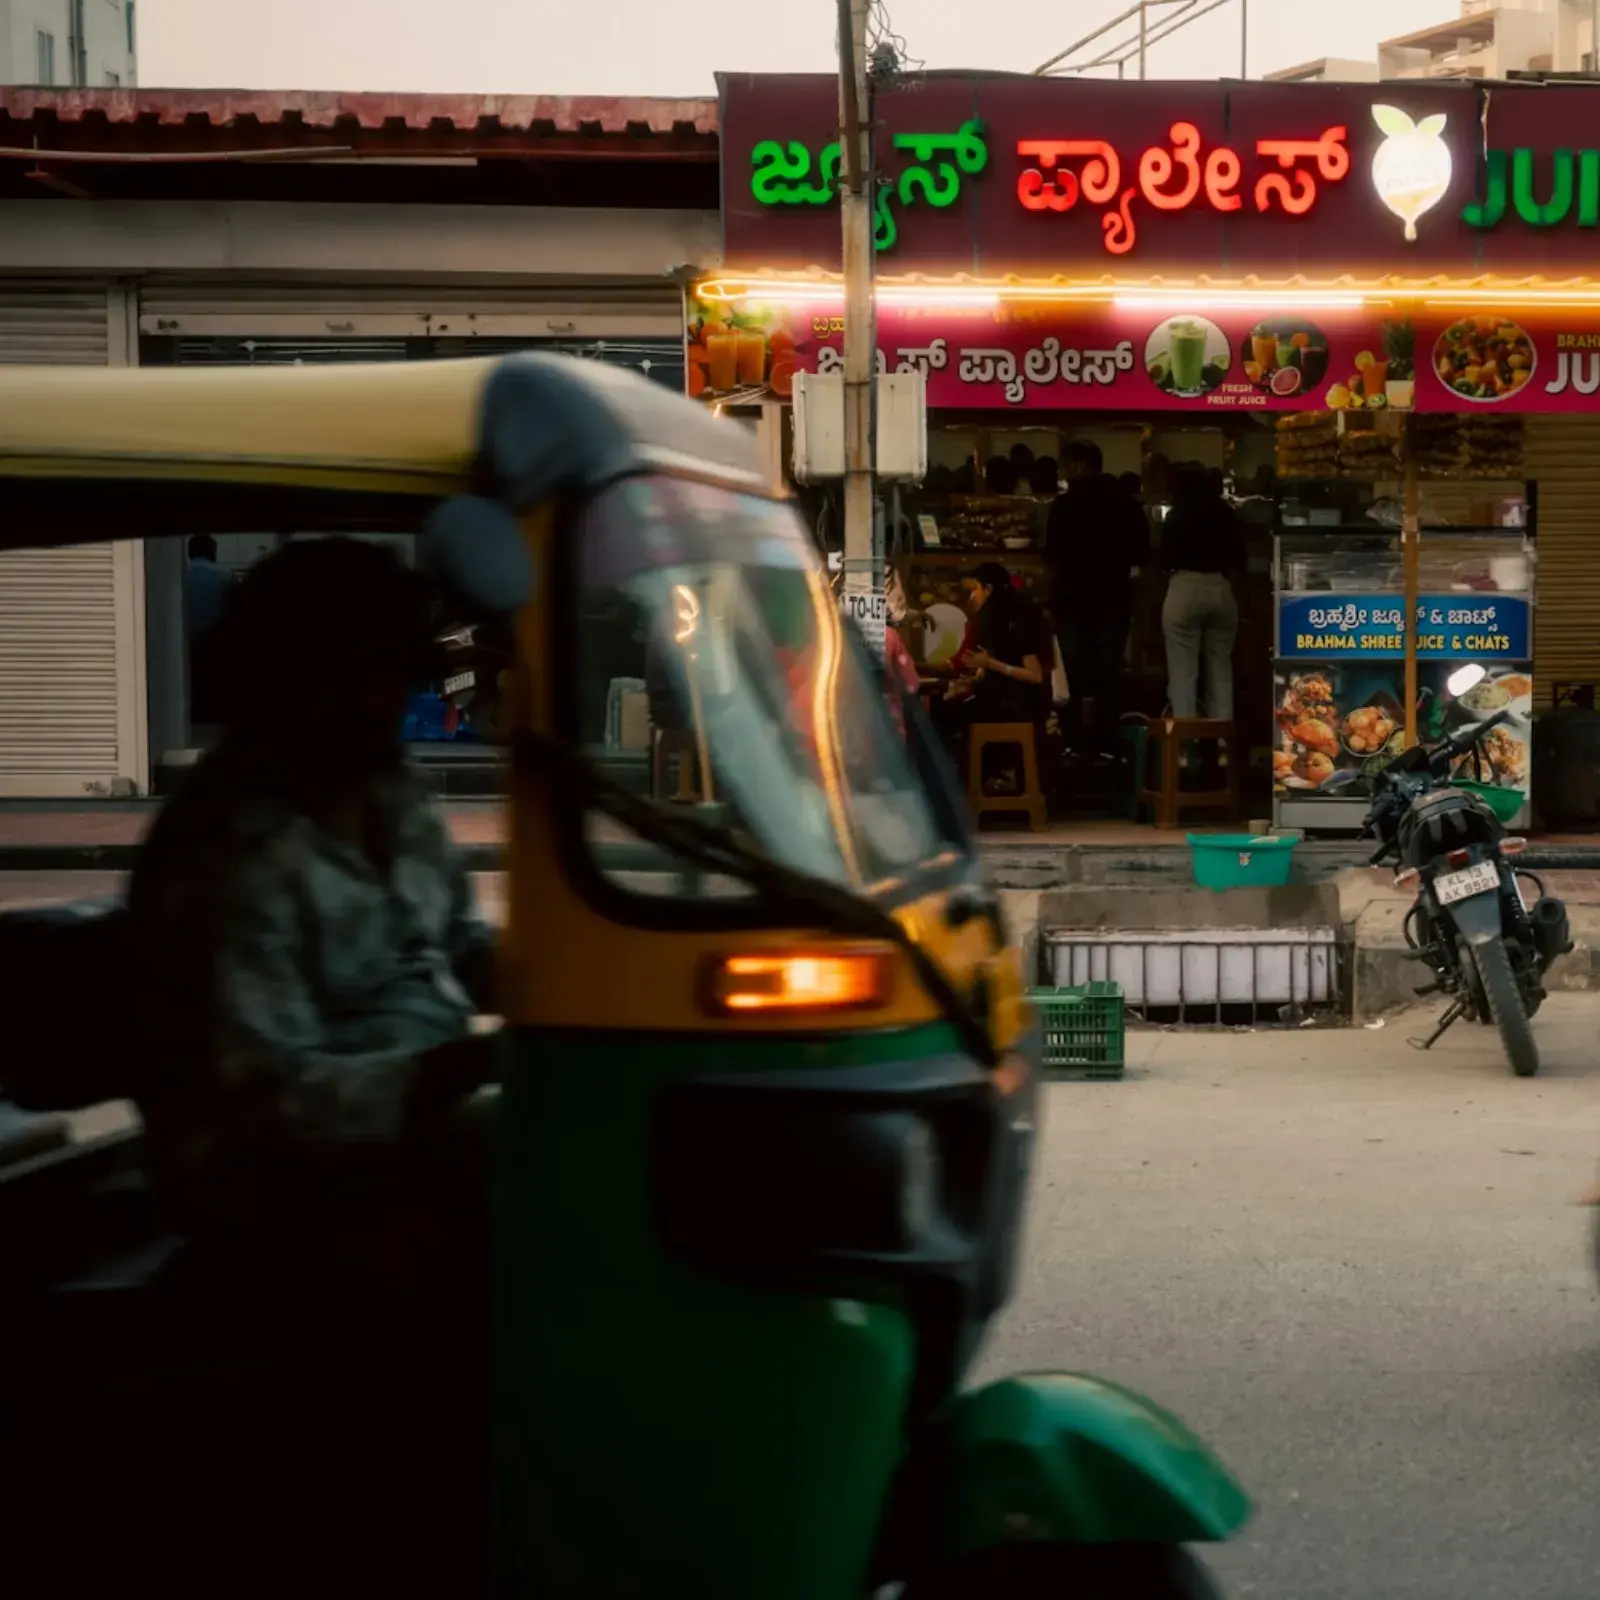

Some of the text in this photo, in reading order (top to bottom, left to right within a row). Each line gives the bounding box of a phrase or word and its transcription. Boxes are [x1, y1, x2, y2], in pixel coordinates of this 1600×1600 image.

[1017, 121, 1350, 254] ಪ್ಯಾಲೇಸ್
[959, 338, 1133, 403] ಪ್ಯಾಲೇಸ್
[1207, 396, 1266, 405] FRUIT JUICE
[848, 596, 886, 619] TO-LET
[1430, 609, 1443, 624] &
[1296, 635, 1355, 649] BRAHMA
[1360, 635, 1402, 649] SHREE
[1451, 636, 1462, 649] &
[1465, 636, 1510, 650] CHATS
